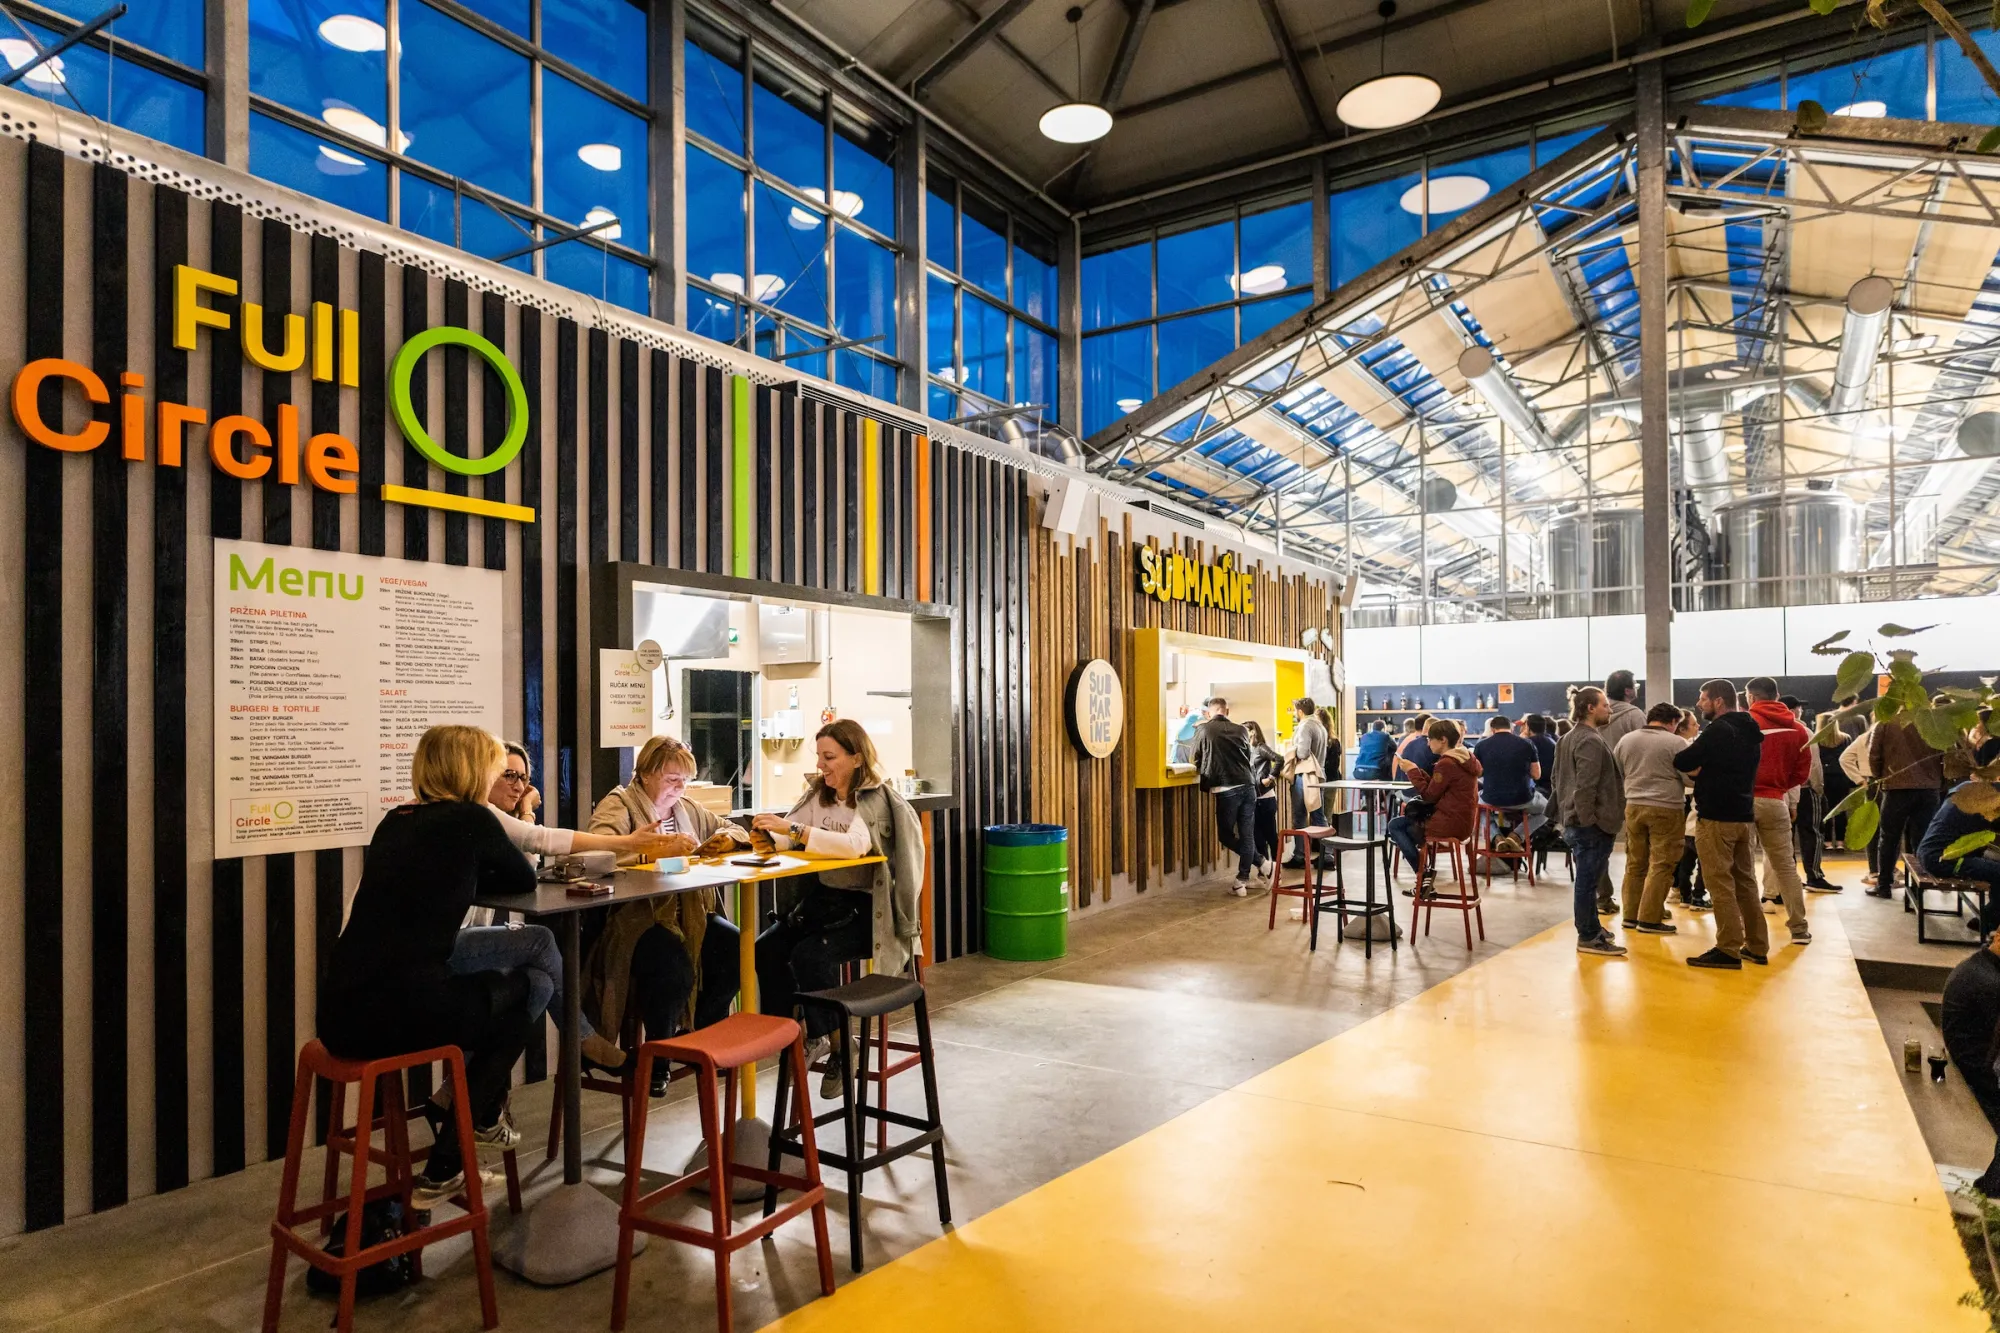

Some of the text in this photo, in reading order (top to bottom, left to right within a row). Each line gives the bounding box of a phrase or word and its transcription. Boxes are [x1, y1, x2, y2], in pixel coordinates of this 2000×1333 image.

[173, 265, 359, 388] Full
[11, 358, 360, 494] Circle
[229, 554, 364, 602] Menu
[379, 577, 428, 587] VEGE/VEGAN
[230, 605, 308, 618] PRŽENA PILETINA
[1089, 671, 1112, 695] SUB
[230, 705, 320, 713] BURGERI & TORTILJE
[1089, 694, 1112, 720] MAR
[250, 803, 271, 814] Full
[236, 816, 271, 828] Circle
